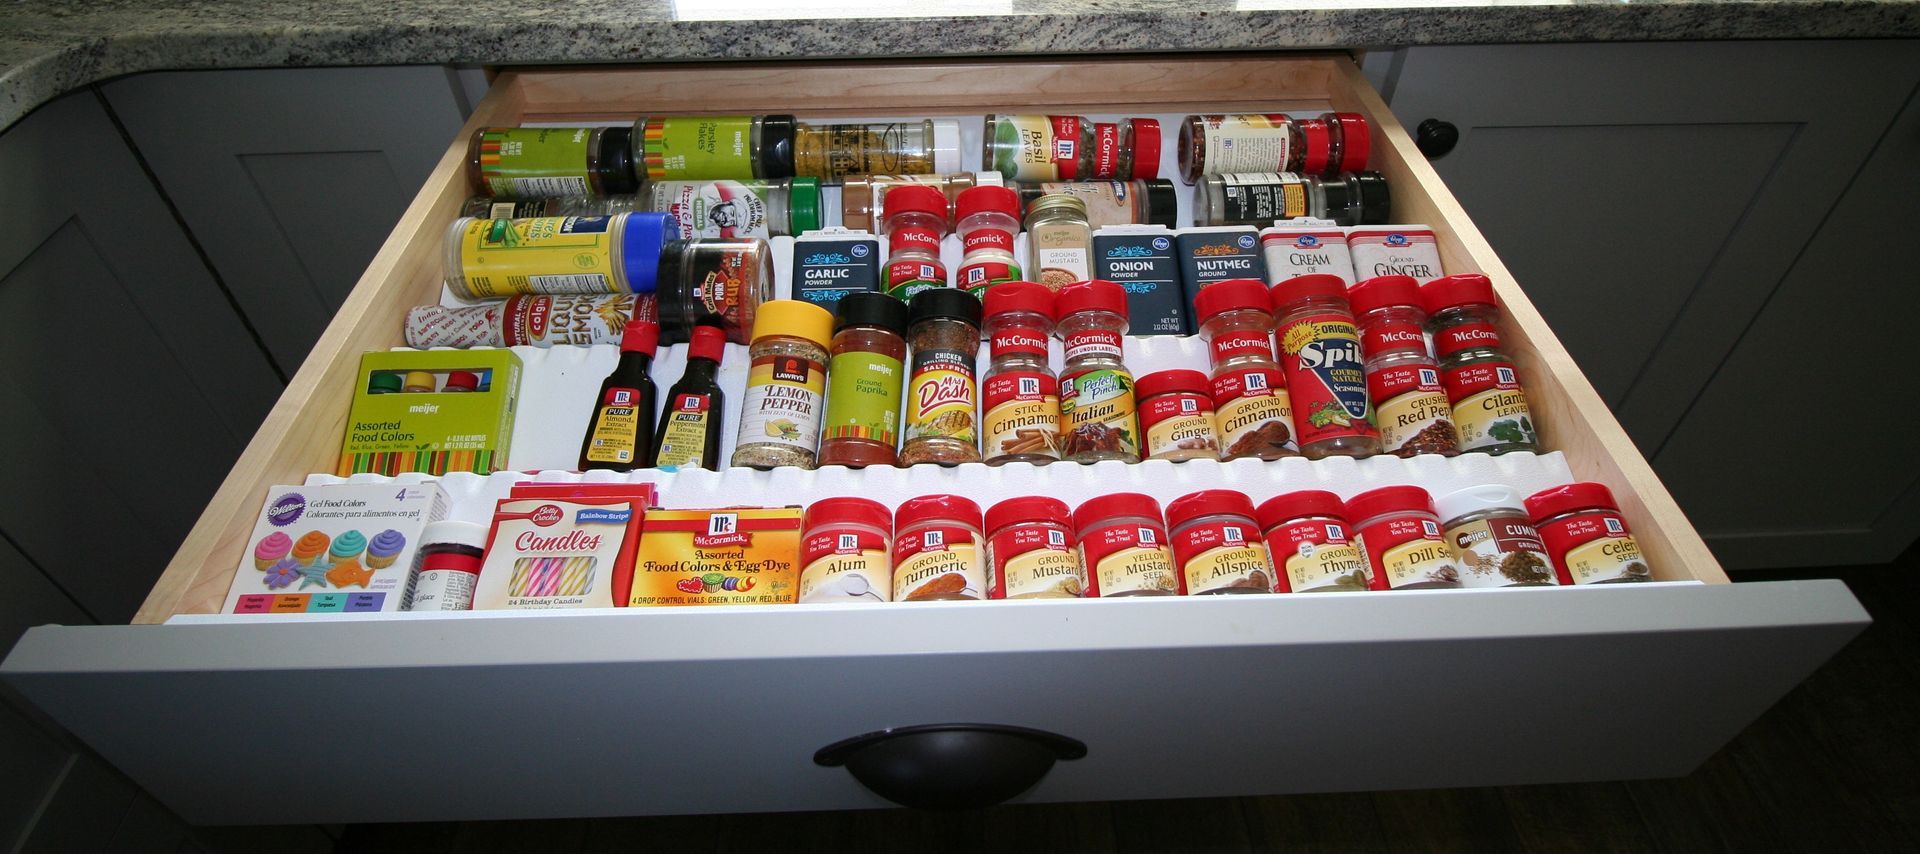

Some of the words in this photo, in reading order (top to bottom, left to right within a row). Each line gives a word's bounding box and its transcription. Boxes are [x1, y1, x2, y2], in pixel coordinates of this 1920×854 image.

[1021, 128, 1034, 164] LEAVES
[1030, 130, 1047, 165] Basil
[1101, 125, 1114, 178] McCormick
[681, 185, 694, 210] Pizza
[684, 212, 693, 222] &
[682, 223, 694, 240] Pas
[903, 232, 939, 247] McCorm
[1109, 260, 1154, 272] ONION
[1197, 259, 1250, 271] NUTMEG
[1289, 253, 1330, 266] CREAM
[804, 268, 850, 279] GARLIC
[1374, 262, 1433, 278] GINGER
[714, 282, 725, 301] PORK
[725, 278, 741, 306] RUB
[551, 294, 573, 346] LIQUI
[571, 295, 594, 345] SMOK
[1065, 334, 1117, 349] McCormick
[1287, 331, 1312, 352] Purpose
[1292, 329, 1300, 340] All
[1099, 345, 1114, 353] LABEL
[1217, 338, 1270, 352] McCormick
[934, 352, 962, 362] CHICKEN
[1299, 341, 1364, 371] Spik
[868, 362, 893, 376] meijer
[1395, 370, 1411, 378] Taste
[856, 378, 883, 387] Ground
[940, 376, 961, 388] Mrs
[1083, 374, 1114, 393] Perfect
[1384, 380, 1396, 388] You
[764, 385, 813, 402] LEMON
[856, 385, 889, 397] Paprika
[917, 379, 971, 409] Dash
[1091, 383, 1118, 401] Pinch
[1333, 383, 1366, 397] Seasoning
[409, 402, 440, 414] meijer
[760, 397, 812, 415] PEPPER
[1236, 398, 1281, 415] GROUND
[1410, 395, 1448, 409] CRUSHE
[1014, 404, 1044, 416] STICK
[1071, 403, 1115, 425] Italian
[1397, 408, 1426, 427] Red
[1429, 405, 1450, 421] Pep
[1497, 405, 1528, 418] LEAVES
[353, 420, 402, 431] Assorted
[604, 415, 631, 423] Almond
[669, 420, 706, 430] Peppermint
[993, 414, 1059, 435] Cinnamon
[1173, 418, 1208, 430] GROUND
[1224, 408, 1291, 434] Cinnamon
[351, 431, 379, 443] Food
[380, 430, 415, 442] Colors
[1171, 427, 1211, 442] Ginger
[395, 488, 407, 502] 4
[269, 502, 304, 516] Wilton
[310, 499, 323, 508] Gel
[324, 499, 341, 508] Food
[343, 499, 367, 508] Colors
[306, 510, 344, 519] Colorantes
[344, 511, 360, 520] para
[361, 509, 397, 518] alimentos
[408, 509, 420, 519] gel
[532, 512, 560, 523] Crocker
[539, 506, 558, 516] Betty
[579, 511, 608, 520] Rainbow
[608, 511, 630, 521] Stripe
[515, 529, 602, 552] Candles
[694, 533, 744, 545] McCormick
[1105, 537, 1116, 545] You
[1190, 538, 1200, 546] You
[1459, 529, 1489, 546] meijer
[695, 550, 744, 560] Assorted
[1320, 548, 1357, 561] GROUND
[1601, 540, 1638, 556] Celer
[912, 552, 957, 571] GROUND
[1038, 555, 1075, 565] GROUND
[1132, 553, 1165, 563] YELLOW
[1215, 550, 1257, 564] GROUND
[1408, 547, 1435, 565] Dill
[1616, 551, 1639, 563] SEED
[643, 560, 678, 573] Food
[680, 559, 721, 573] Colors
[722, 561, 733, 572] &
[734, 560, 761, 573] Egg
[762, 559, 791, 572] Dye
[826, 559, 867, 575] Alum
[904, 560, 968, 586] Turmeric
[1032, 565, 1079, 580] Mustard
[1126, 559, 1171, 576] Mustard
[1211, 559, 1263, 580] Allspice
[1320, 559, 1362, 575] Thyme
[1143, 572, 1164, 581] SEED
[519, 598, 552, 607] Birthday
[553, 597, 583, 605] Candles
[637, 597, 656, 605] DROP
[656, 596, 685, 604] CONTROL
[687, 596, 707, 604] VIALS:
[708, 596, 729, 604] GREEN,
[731, 595, 757, 604] YELLOW,
[775, 594, 792, 602] BLUE
